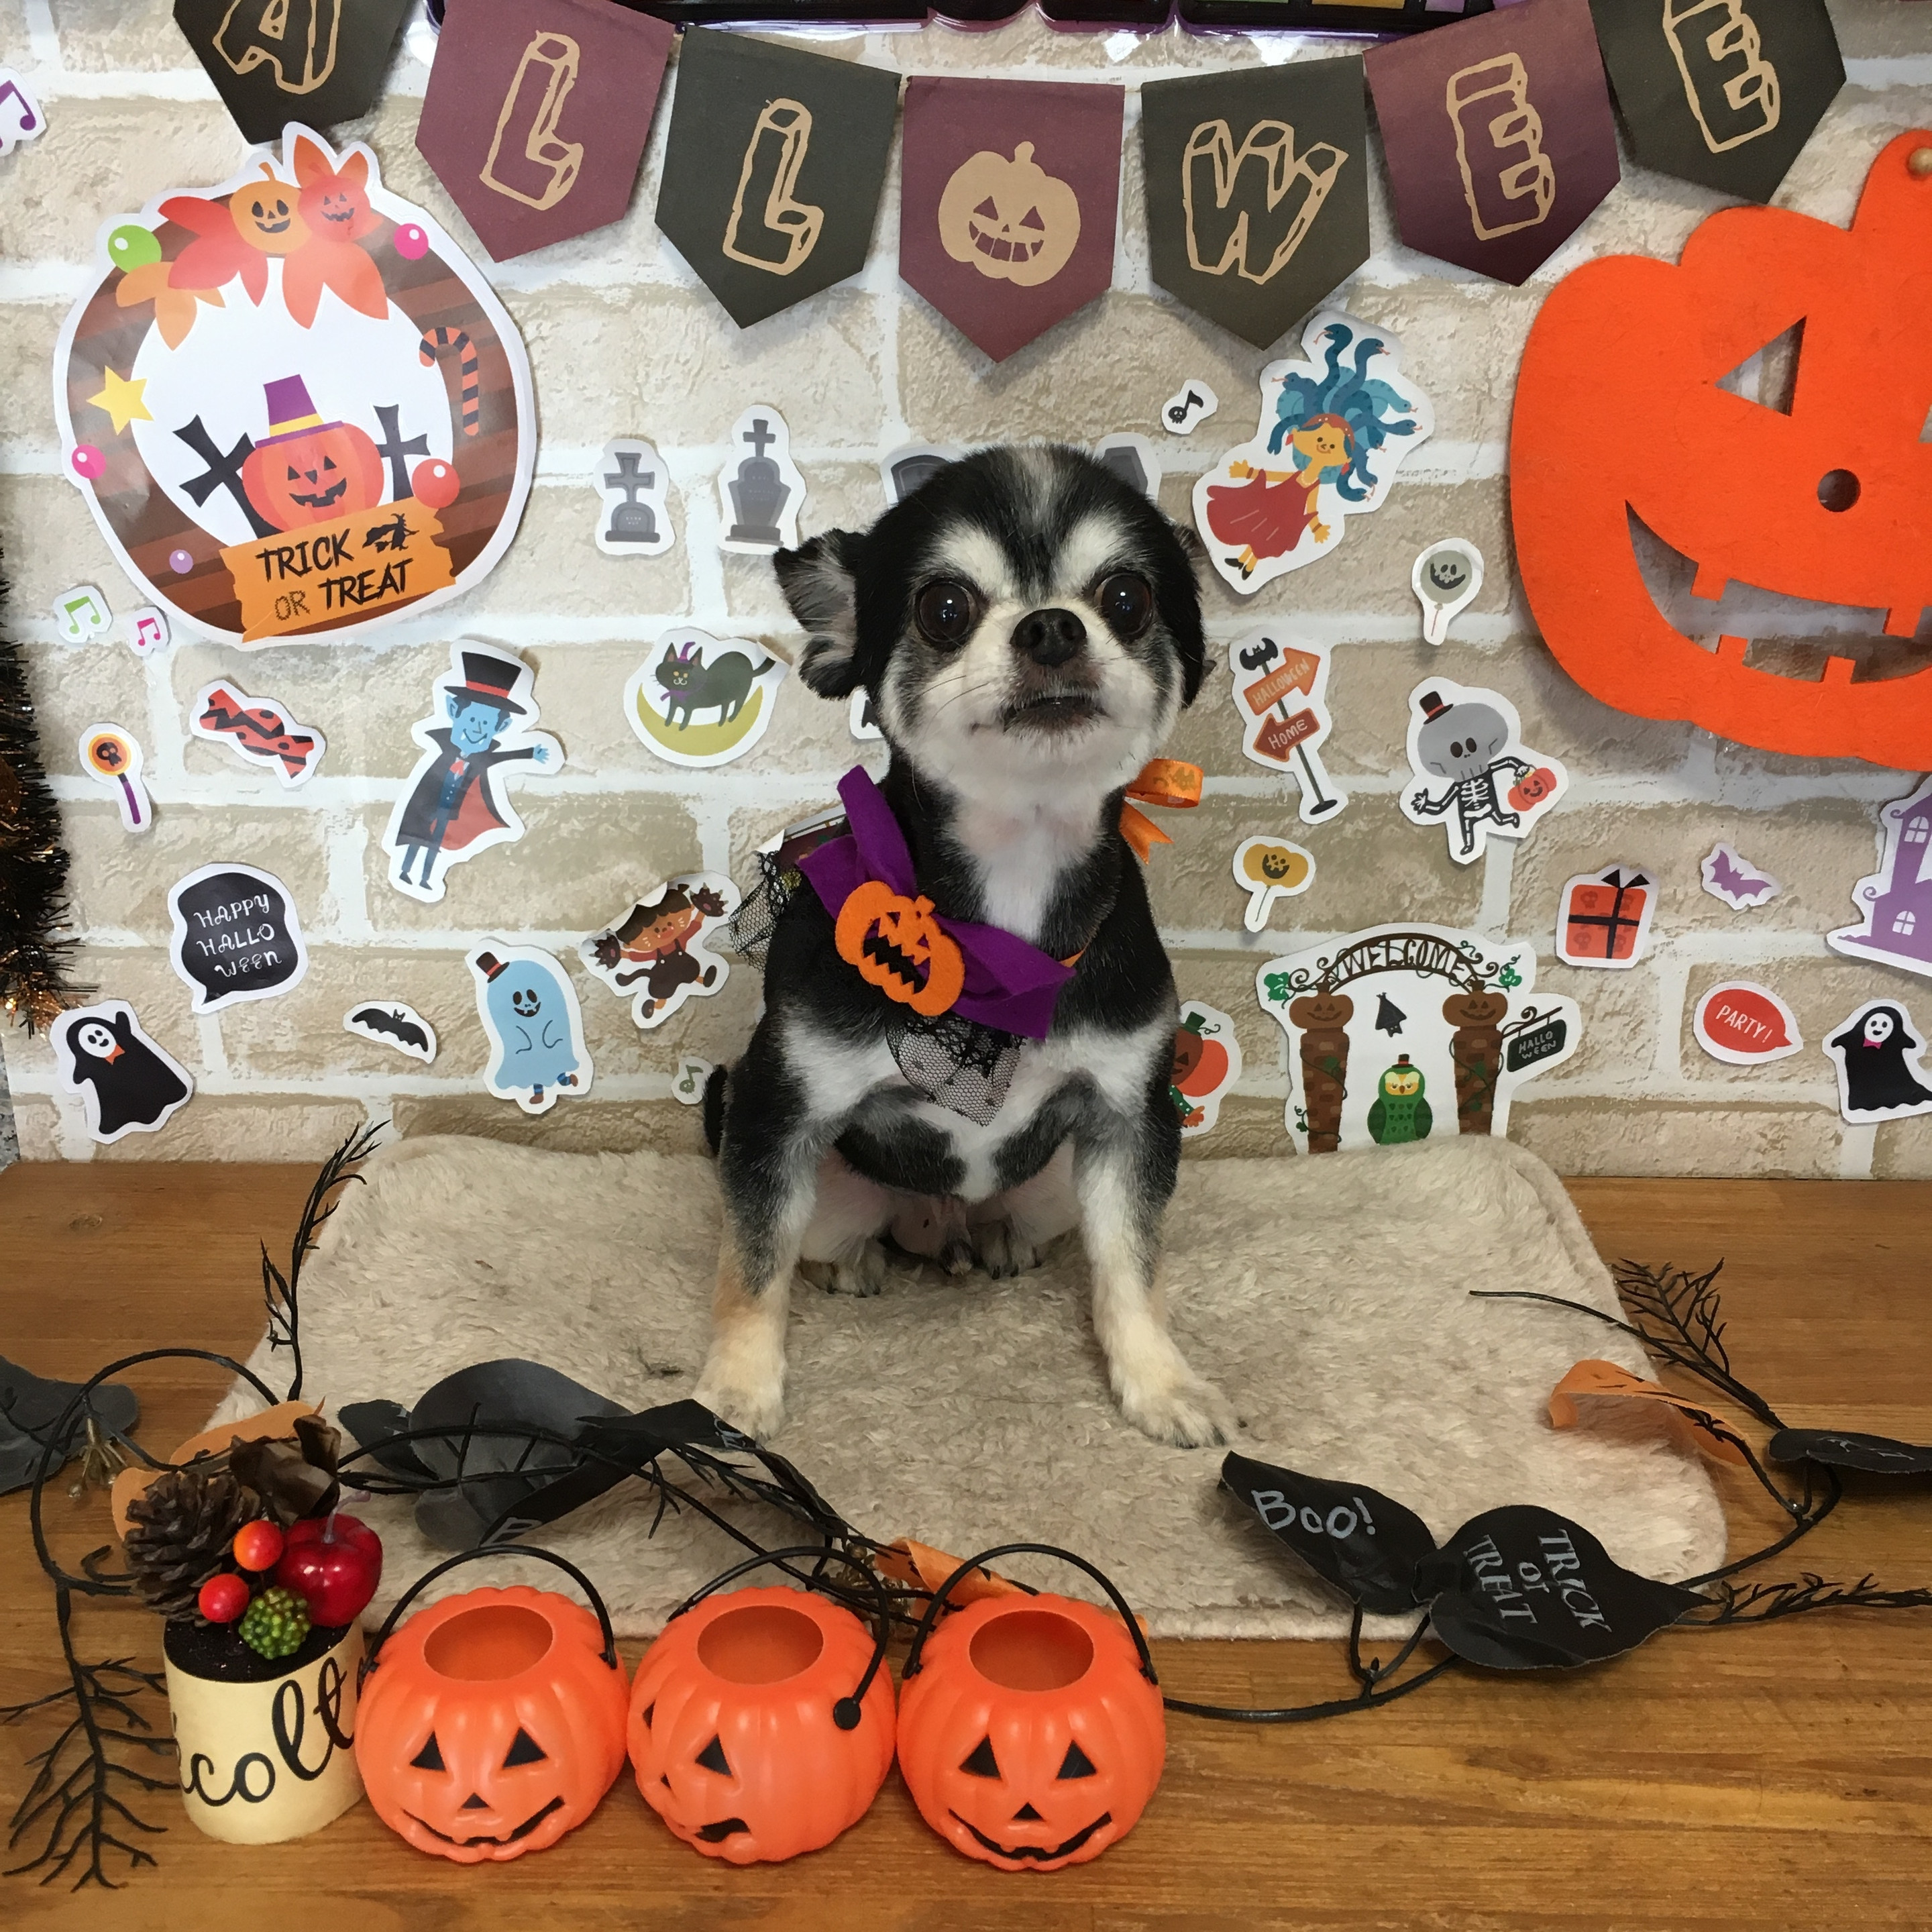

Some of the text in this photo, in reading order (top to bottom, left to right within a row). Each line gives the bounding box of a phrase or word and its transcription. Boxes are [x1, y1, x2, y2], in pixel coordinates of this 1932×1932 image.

[255, 529, 354, 582] TRICK
[274, 558, 414, 621] OR TREAT
[1252, 658, 1310, 706] HALLOWEEN
[1268, 719, 1308, 749] HOME
[196, 923, 275, 956] HALLO
[1341, 938, 1468, 982] WELCOME
[1518, 1030, 1553, 1054] HALLO
[1715, 1005, 1773, 1043] PARTY!
[1521, 1040, 1556, 1059] WEEN
[1463, 1534, 1538, 1623] TREAT
[1538, 1528, 1612, 1632] TRICK
